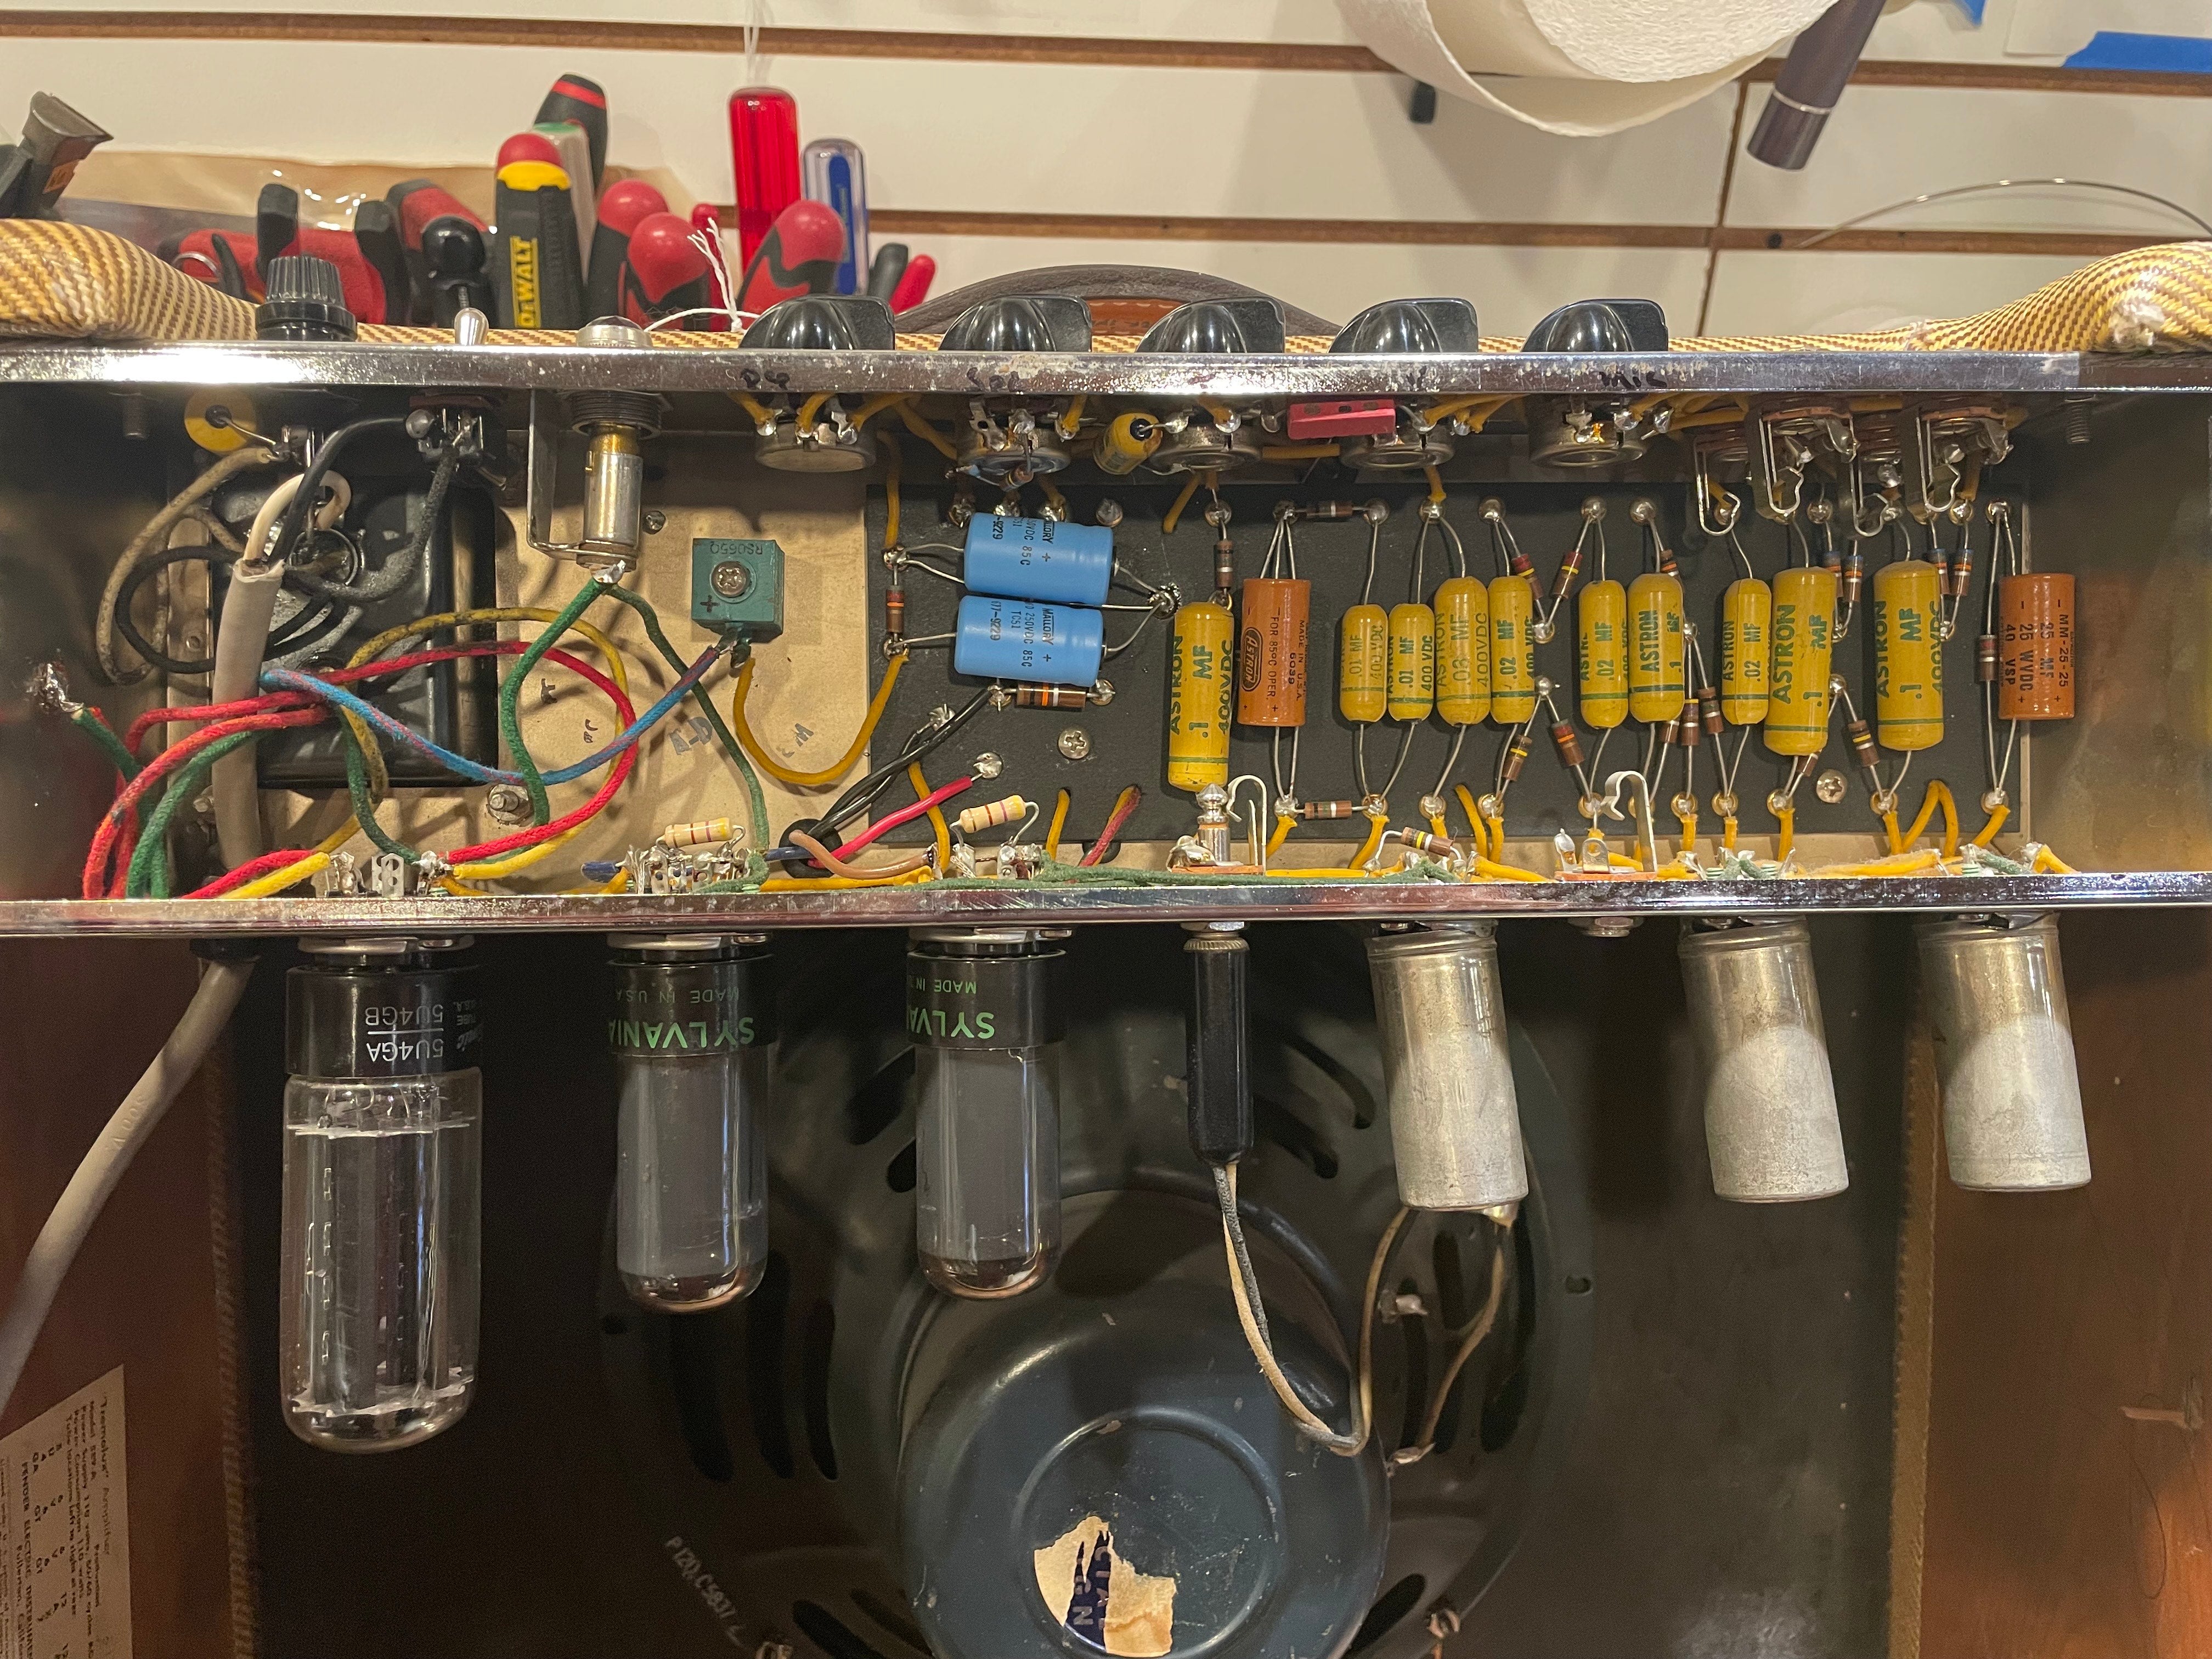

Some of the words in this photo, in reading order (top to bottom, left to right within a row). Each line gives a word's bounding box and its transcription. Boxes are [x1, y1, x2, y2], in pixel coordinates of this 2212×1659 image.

[1020, 545, 1032, 566] 85C
[1011, 610, 1022, 629] TC51
[1023, 613, 1034, 645] 250VDC
[1042, 607, 1054, 646] MALLORY
[1269, 616, 1279, 636] FOR
[1449, 614, 1470, 641] MF
[1497, 618, 1515, 640] MF
[1899, 608, 1922, 642] MF
[1350, 634, 1363, 652] MF
[1370, 624, 1384, 652] VDC
[1594, 621, 1613, 642] MF
[1638, 610, 1660, 673] ASTRON
[1743, 622, 1761, 642] MF
[1808, 614, 1827, 650] MF
[2005, 624, 2016, 642] 40
[1399, 636, 1415, 654] MF
[1421, 635, 1433, 660] VDC
[1435, 612, 1447, 687] ASTRON
[1723, 620, 1735, 681] ASTRON
[1772, 604, 1796, 705] ASTRON
[1874, 601, 1889, 699] ASTRON
[1021, 654, 1032, 668] 85C
[1193, 644, 1213, 680] MF
[1243, 636, 1260, 686] ASTRON
[1297, 652, 1304, 663] IN
[1348, 659, 1363, 678] .01
[1499, 657, 1517, 679] .02
[1579, 632, 1589, 682] ASTR
[1669, 661, 1681, 674] .1
[1399, 669, 1414, 689] .01
[1421, 663, 1432, 691] 400
[1596, 658, 1615, 681] .02
[1743, 659, 1761, 682] .02
[2005, 658, 2016, 686] VSP
[2019, 649, 2034, 692] WVDC
[1169, 635, 1183, 736] ASTRON
[1217, 640, 1233, 736] 400VDC
[1266, 672, 1277, 701] OPER.
[1899, 684, 1922, 699] .1
[1803, 691, 1822, 707] .1
[1189, 721, 1209, 738] .1
[659, 989, 675, 1003] IN
[690, 989, 739, 1003] MADE
[916, 978, 926, 991] IN
[933, 979, 977, 995] MADE
[365, 1005, 443, 1026] 5U4GB
[608, 1017, 755, 1048] SYLVANIA
[366, 1039, 444, 1062] 5U4GA
